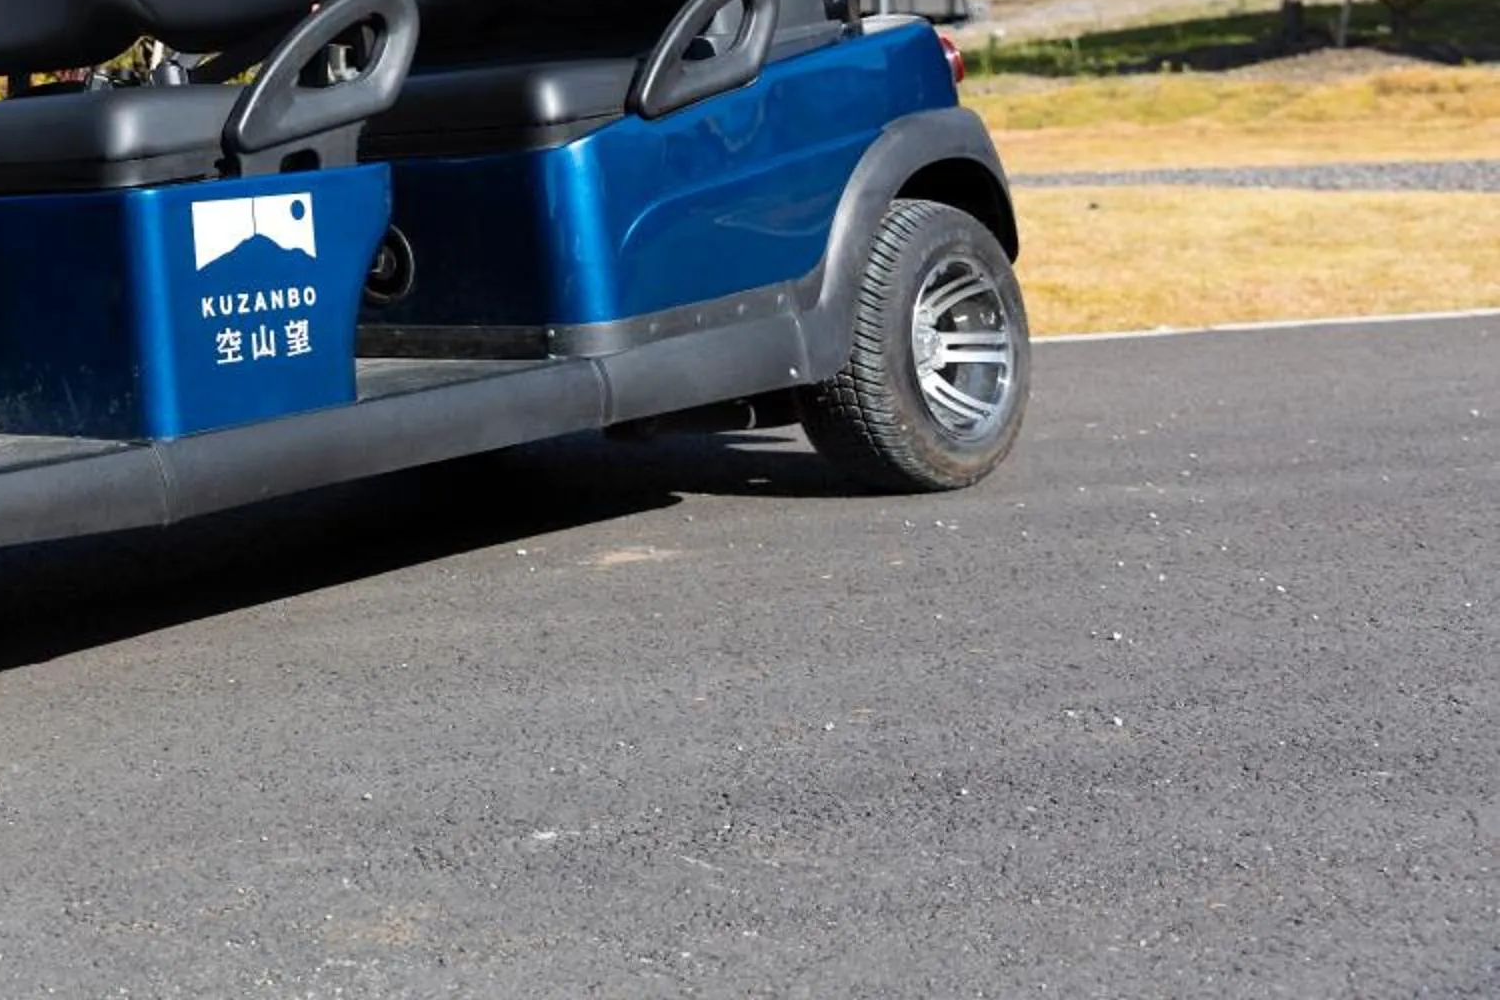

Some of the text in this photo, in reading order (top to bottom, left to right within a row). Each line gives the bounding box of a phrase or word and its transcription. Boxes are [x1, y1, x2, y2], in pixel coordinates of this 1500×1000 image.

[201, 286, 317, 318] KUZANBO
[215, 319, 312, 365] 空山望
